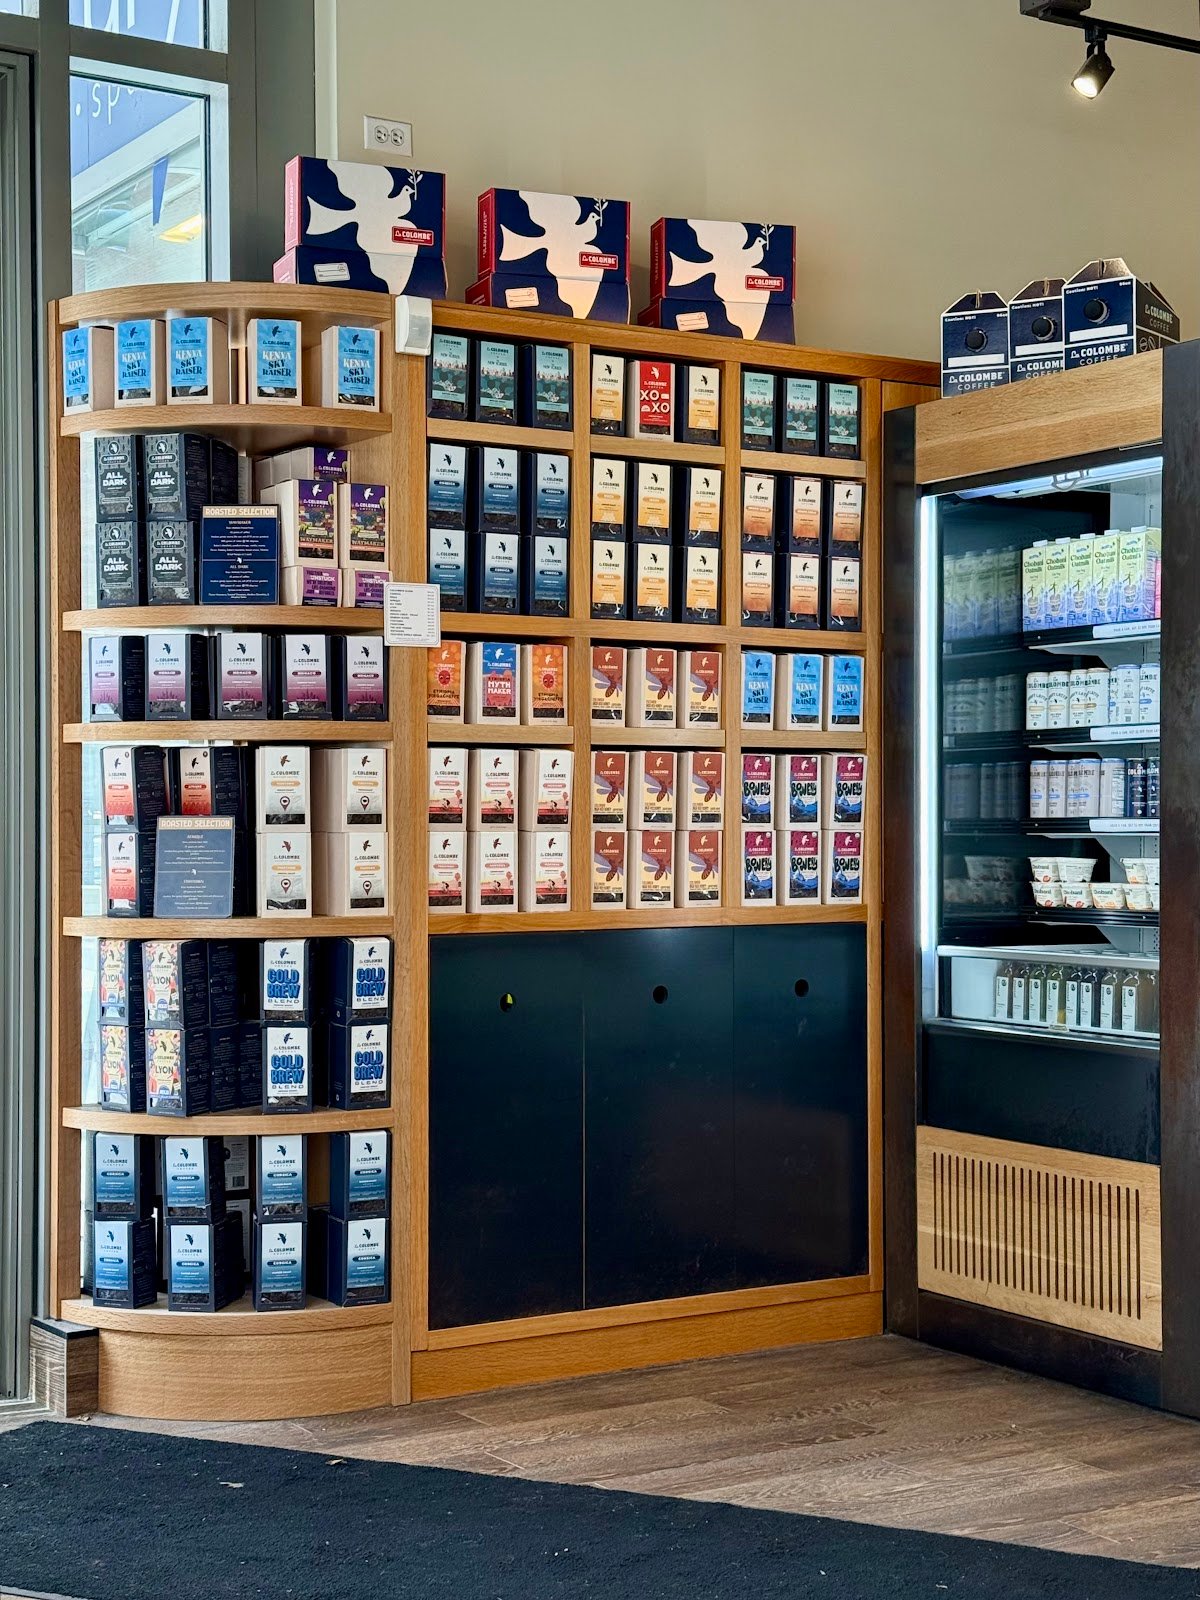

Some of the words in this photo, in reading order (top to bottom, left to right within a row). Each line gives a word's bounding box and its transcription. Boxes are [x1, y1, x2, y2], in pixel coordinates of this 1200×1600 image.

[402, 231, 432, 240] COLOMBE
[588, 256, 617, 264] COLOMBE
[1145, 304, 1150, 314] La
[1150, 305, 1173, 323] COLOMBE
[1150, 319, 1170, 332] COFFEE
[175, 350, 202, 359] KENYA
[1070, 350, 1080, 358] La
[1080, 343, 1126, 357] COLOMBE
[122, 352, 146, 362] KENYA
[263, 351, 291, 360] KENYA
[127, 360, 141, 370] SKY
[181, 358, 197, 368] SKY
[268, 360, 285, 369] SKY
[343, 359, 370, 368] KENYA
[175, 366, 202, 375] RAISER
[263, 368, 291, 377] RAISER
[349, 368, 364, 376] SKY
[1017, 364, 1026, 372] La
[122, 369, 146, 378] RAISER
[949, 376, 958, 384] La
[958, 372, 1003, 382] COLOMBE
[343, 376, 370, 385] RAISER
[958, 382, 996, 390] COFFEE
[640, 390, 660, 401] XO
[651, 402, 670, 413] XO
[103, 478, 127, 486] DARK
[151, 478, 175, 486] DARK
[205, 508, 237, 516] ROASTED
[240, 508, 275, 516] SELECTION
[104, 563, 129, 571] DARK
[155, 563, 182, 571] DARK
[1024, 560, 1043, 568] Chobani
[752, 689, 764, 697] SKY
[800, 690, 812, 698] SKY
[841, 691, 854, 699] SKY
[744, 782, 770, 796] BOWERY
[790, 782, 817, 797] BOWERY
[836, 782, 862, 796] BOWERY
[195, 819, 230, 827] SELECTION
[745, 858, 772, 872] BOWERY
[791, 857, 817, 872] BOWERY
[834, 858, 860, 872] BOWERY
[106, 974, 119, 982] LYON
[268, 969, 300, 983] COLD
[357, 968, 385, 982] COLD
[152, 976, 170, 985] LYON
[267, 984, 300, 998] BREW
[356, 982, 386, 997] BREW
[271, 1054, 304, 1069] COLD
[355, 1051, 383, 1065] COLD
[107, 1061, 120, 1069] LYON
[155, 1066, 173, 1074] LYON
[354, 1065, 384, 1080] BREW
[271, 1069, 305, 1084] BREW
